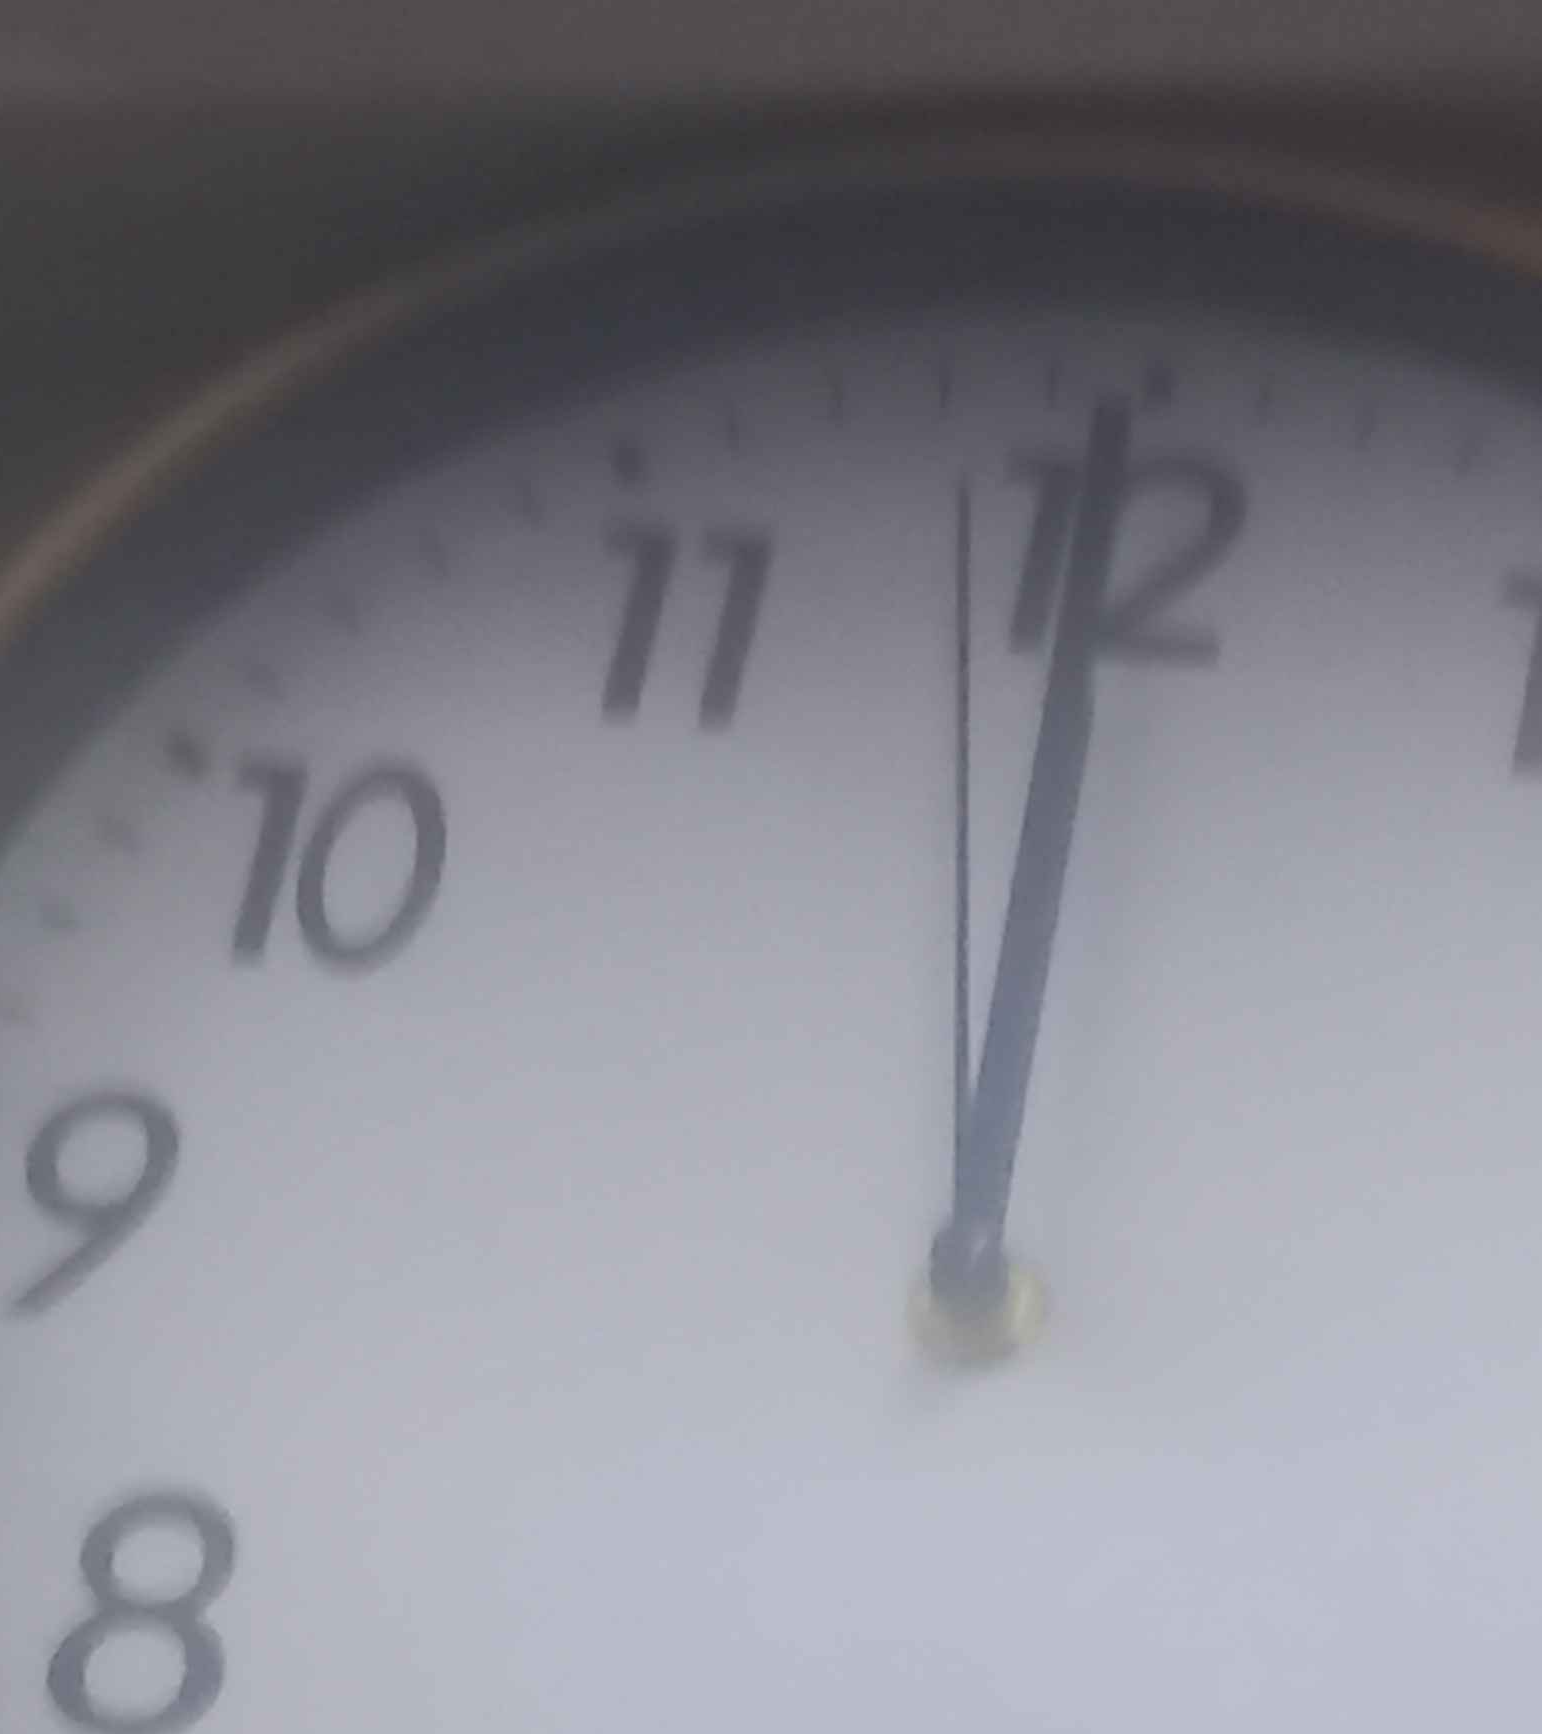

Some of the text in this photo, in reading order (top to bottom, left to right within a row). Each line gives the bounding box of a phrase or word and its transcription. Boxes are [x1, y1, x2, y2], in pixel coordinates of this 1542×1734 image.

[599, 518, 775, 732] 11
[1005, 447, 1249, 668] 12
[231, 752, 447, 976] 10
[2, 1085, 181, 1318] 9
